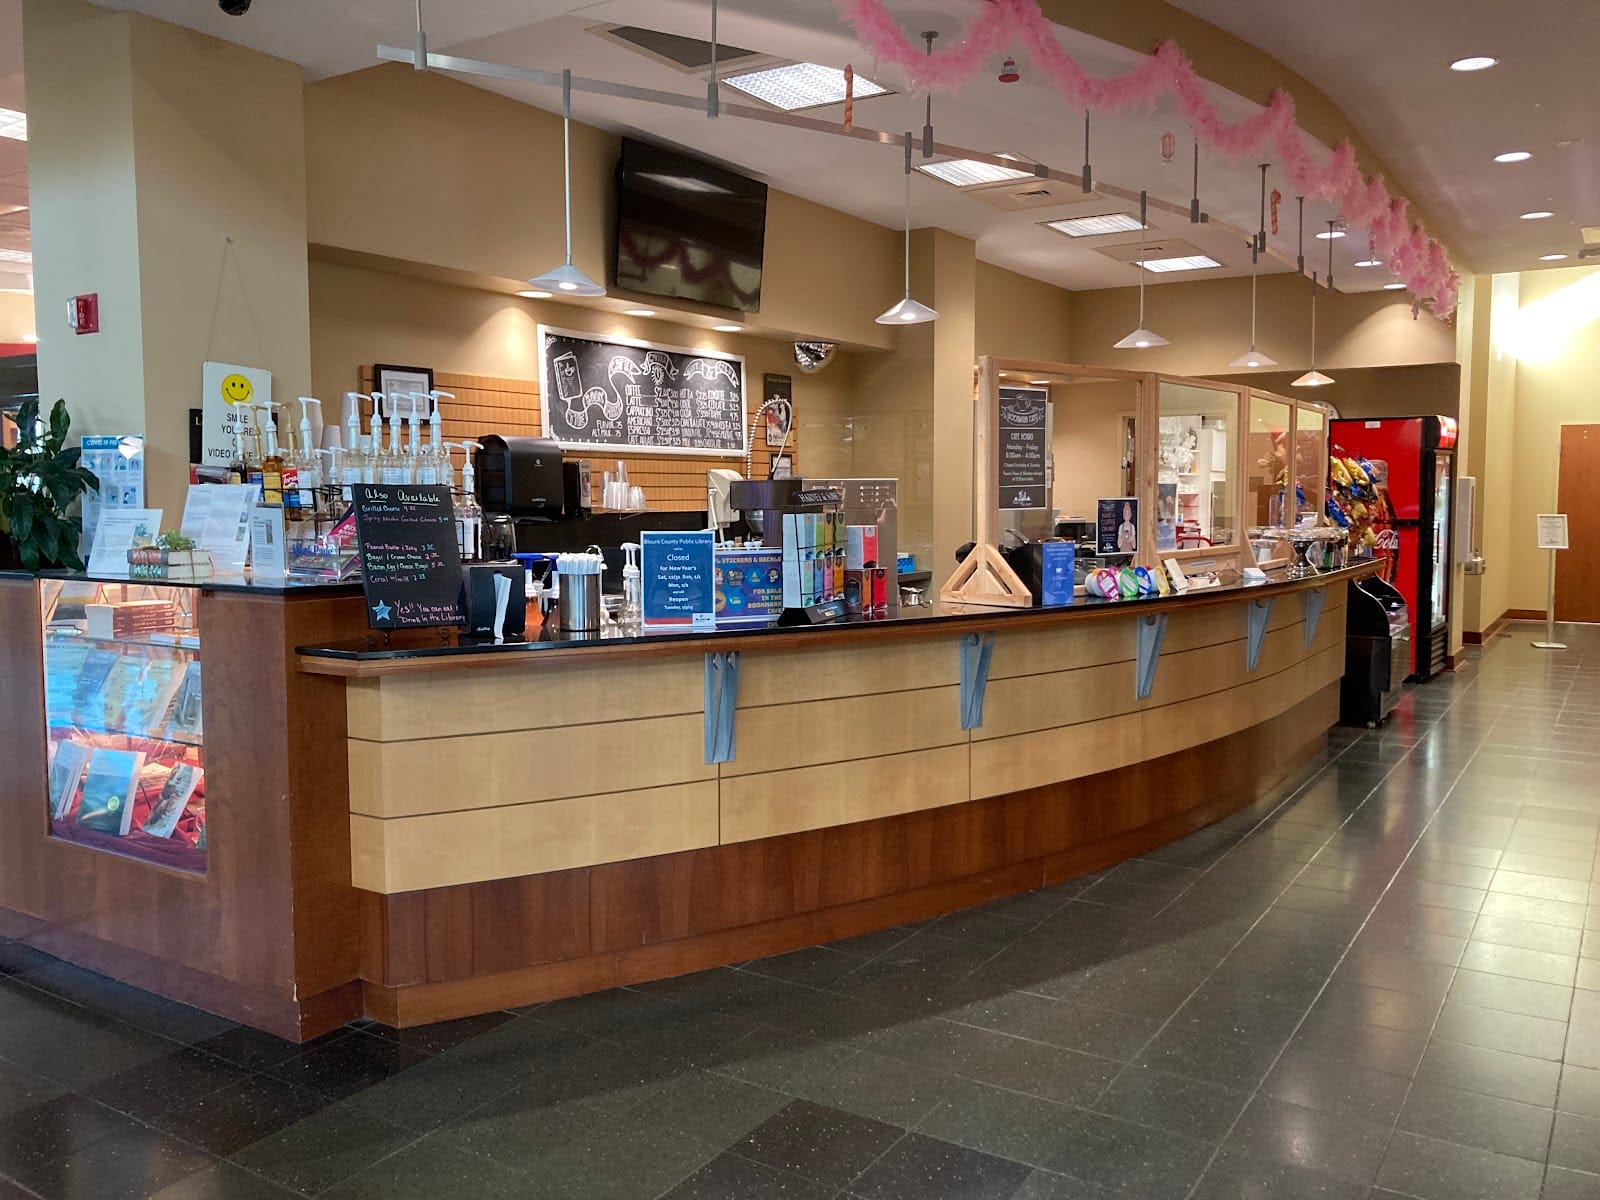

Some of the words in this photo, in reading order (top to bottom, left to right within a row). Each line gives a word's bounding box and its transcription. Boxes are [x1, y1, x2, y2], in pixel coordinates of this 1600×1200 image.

[626, 396, 641, 406] LATTE
[227, 413, 248, 423] SMLE
[628, 426, 650, 434] ESPRESSO
[208, 448, 230, 458] VIDEO
[365, 488, 388, 499] Also
[398, 490, 440, 502] Available
[1373, 529, 1398, 549] Cola
[417, 603, 430, 612] You
[441, 613, 465, 621] Library
